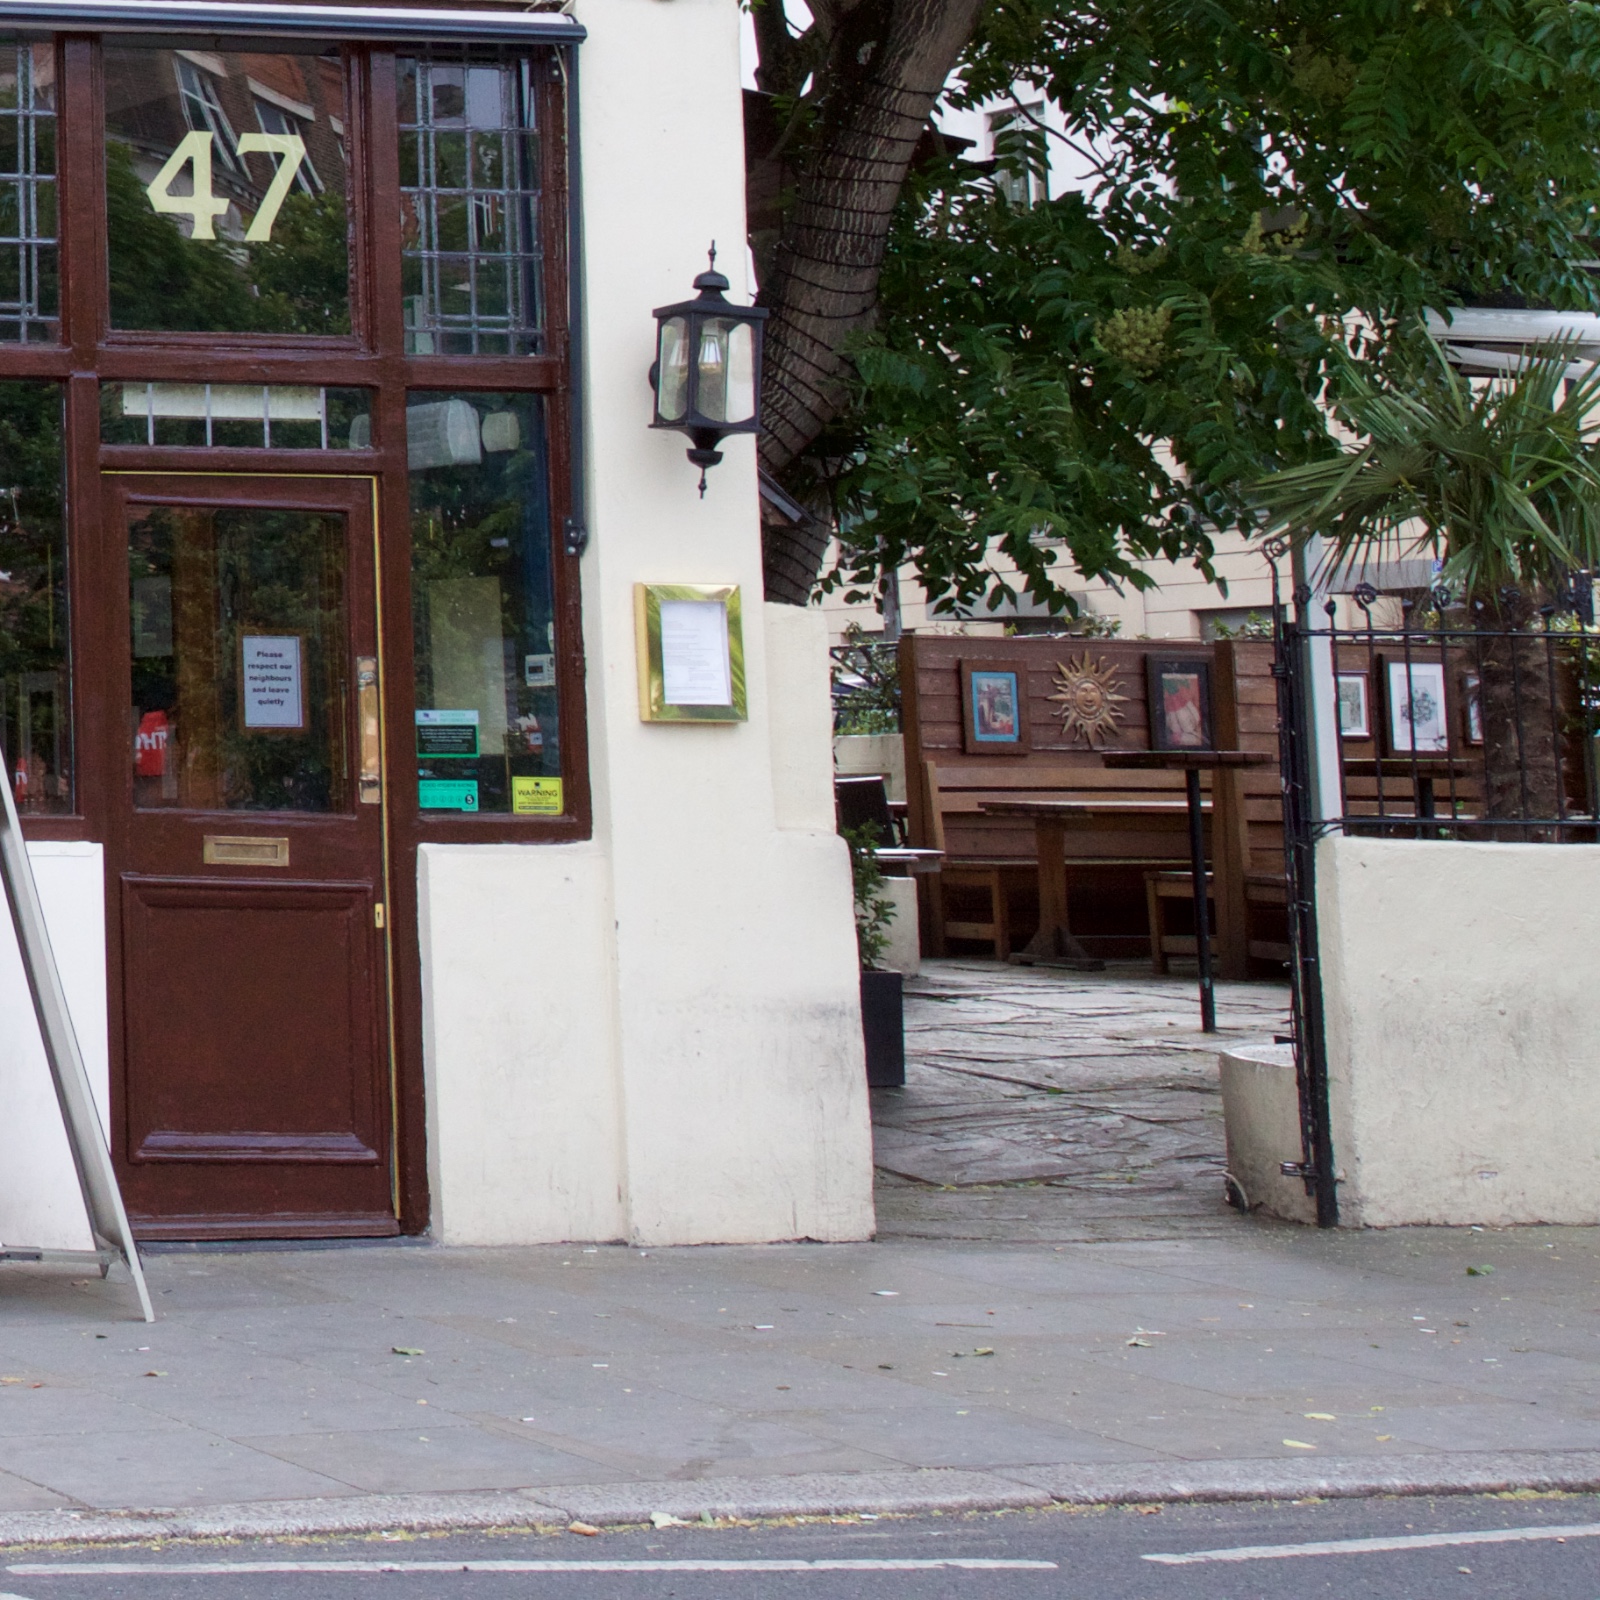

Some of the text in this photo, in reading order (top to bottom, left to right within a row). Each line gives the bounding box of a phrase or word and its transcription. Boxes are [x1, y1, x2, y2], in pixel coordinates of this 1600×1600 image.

[145, 129, 307, 243] 47
[256, 650, 283, 658] Please
[257, 698, 285, 706] quietly
[517, 789, 558, 797] WARNING
